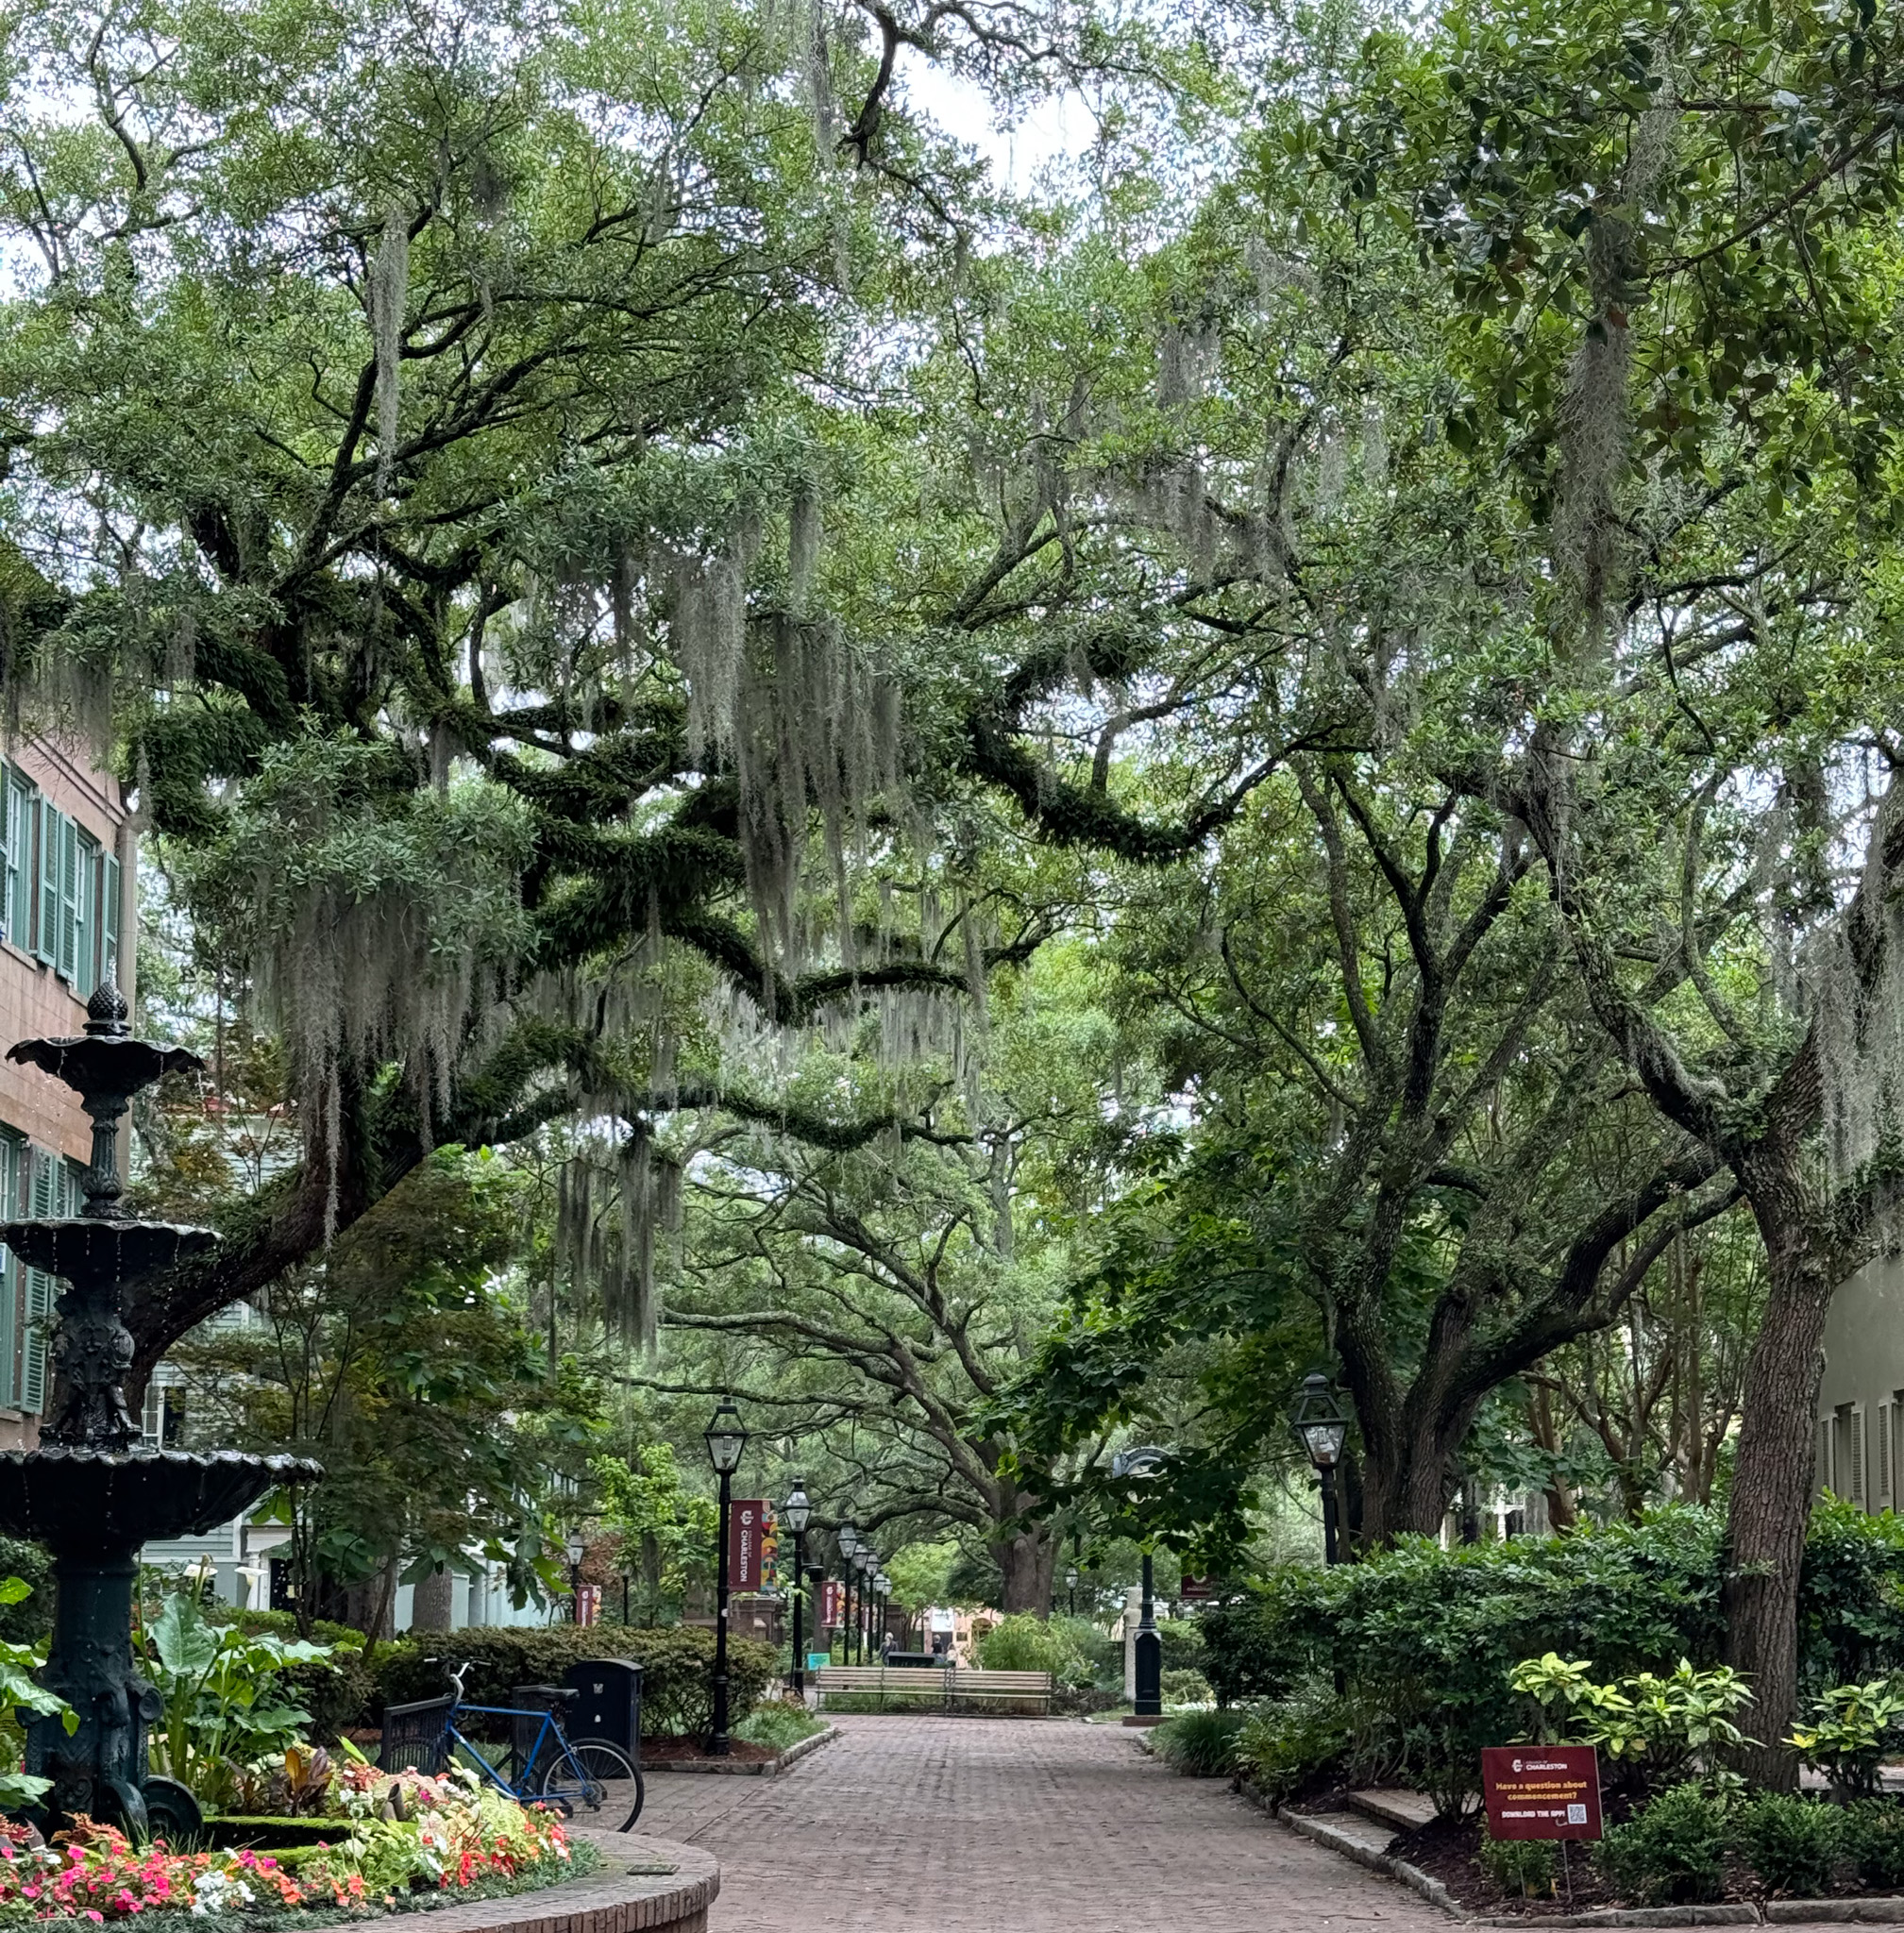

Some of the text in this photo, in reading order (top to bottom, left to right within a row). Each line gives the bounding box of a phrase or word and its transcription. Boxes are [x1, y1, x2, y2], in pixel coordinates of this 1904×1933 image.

[1495, 1782, 1517, 1790] Have
[1525, 1781, 1561, 1791] question
[1562, 1780, 1587, 1790] about
[1507, 1791, 1577, 1801] commencement?
[1501, 1810, 1536, 1819] DOWNLOAD
